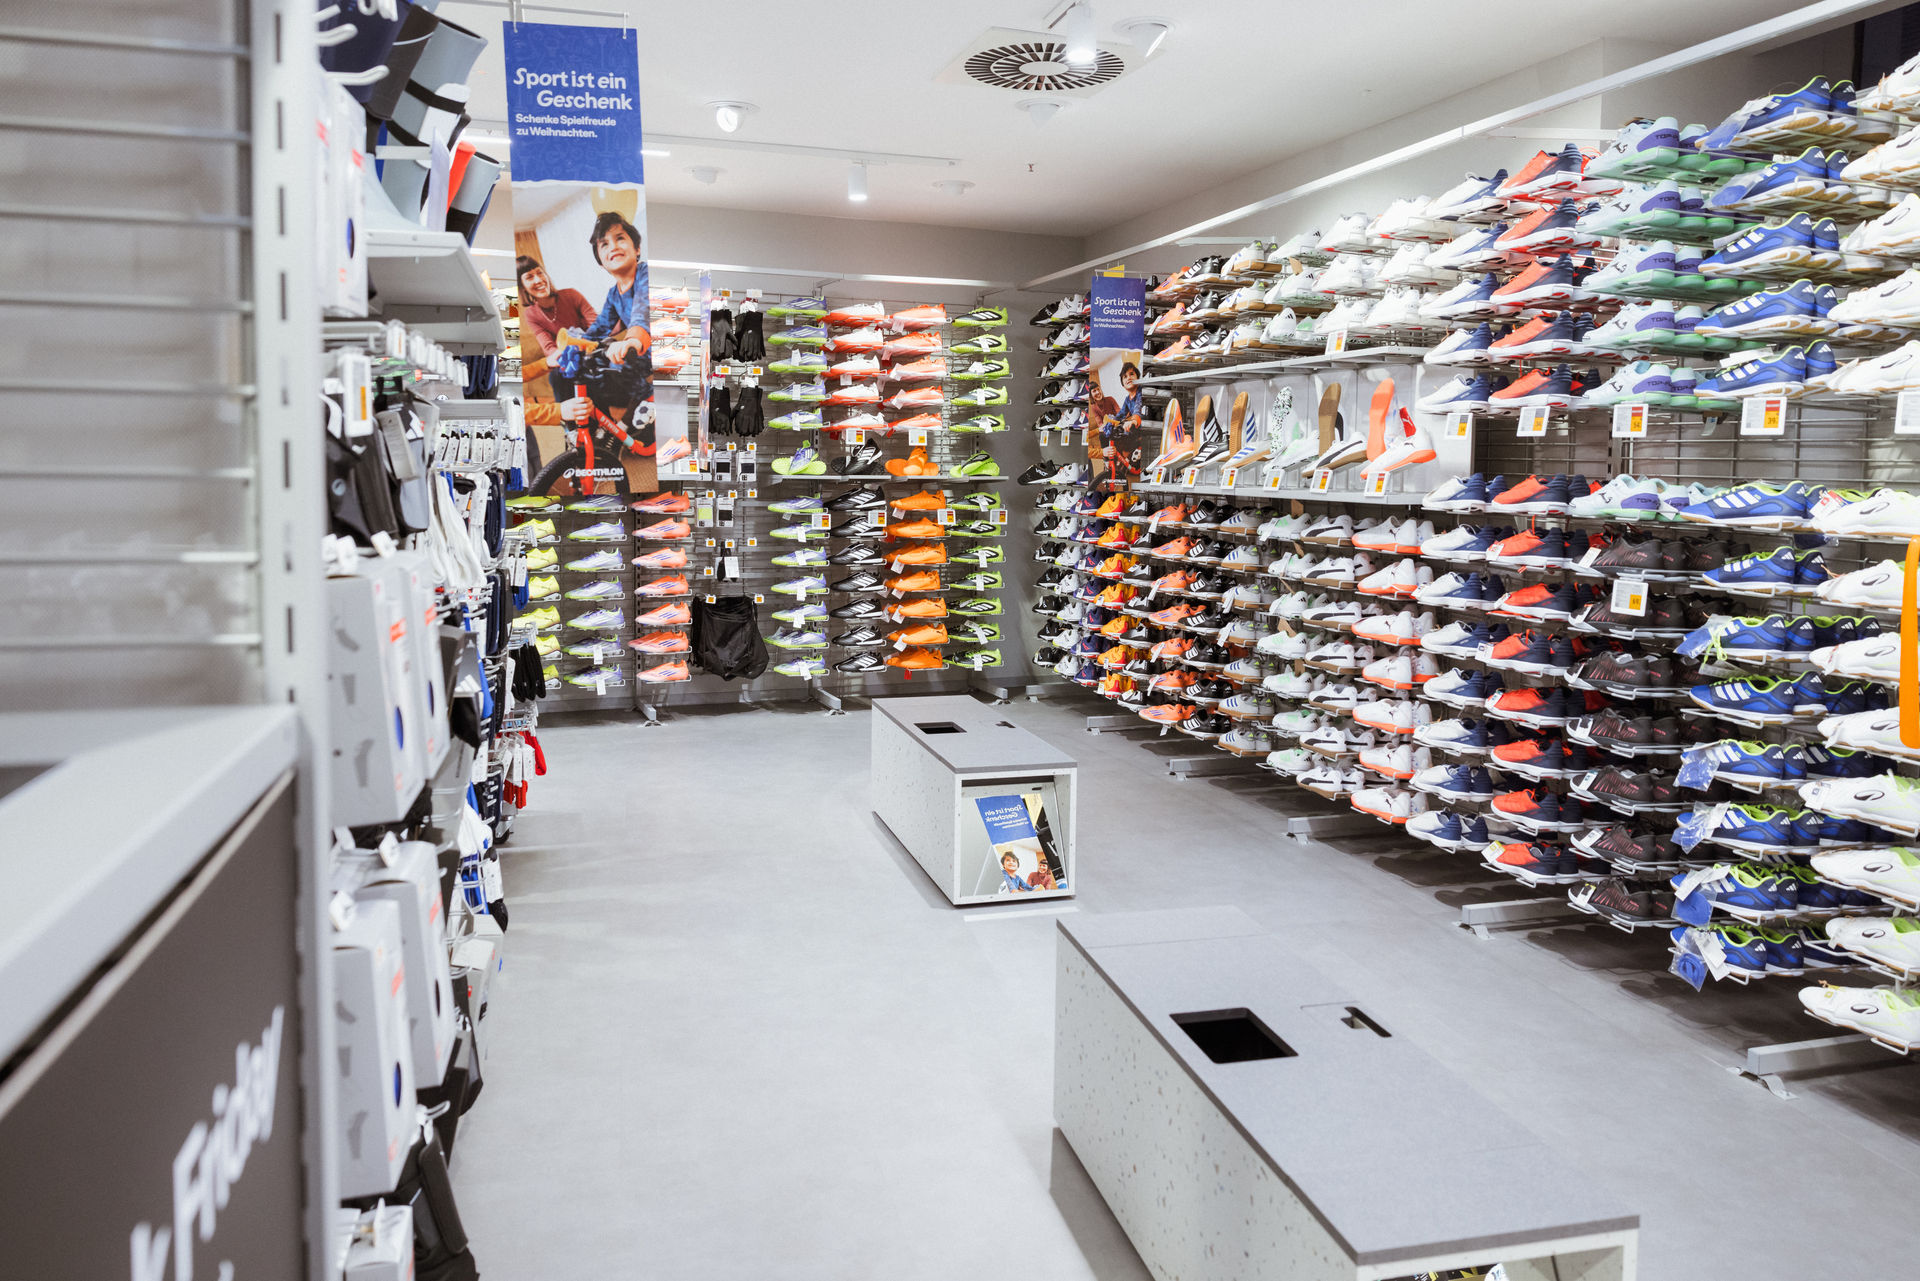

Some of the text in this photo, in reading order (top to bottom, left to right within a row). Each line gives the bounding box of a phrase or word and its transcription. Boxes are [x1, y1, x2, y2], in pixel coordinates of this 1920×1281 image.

[513, 67, 626, 89] Sport ist ein
[536, 90, 633, 110] Geschenk
[515, 113, 616, 127] Schenke Spielfreude
[516, 127, 598, 138] zu Weihnachten.
[1094, 296, 1116, 306] Sport
[1118, 298, 1127, 306] ist
[1103, 306, 1142, 316] Geschenk
[575, 468, 624, 477] DECATHLON
